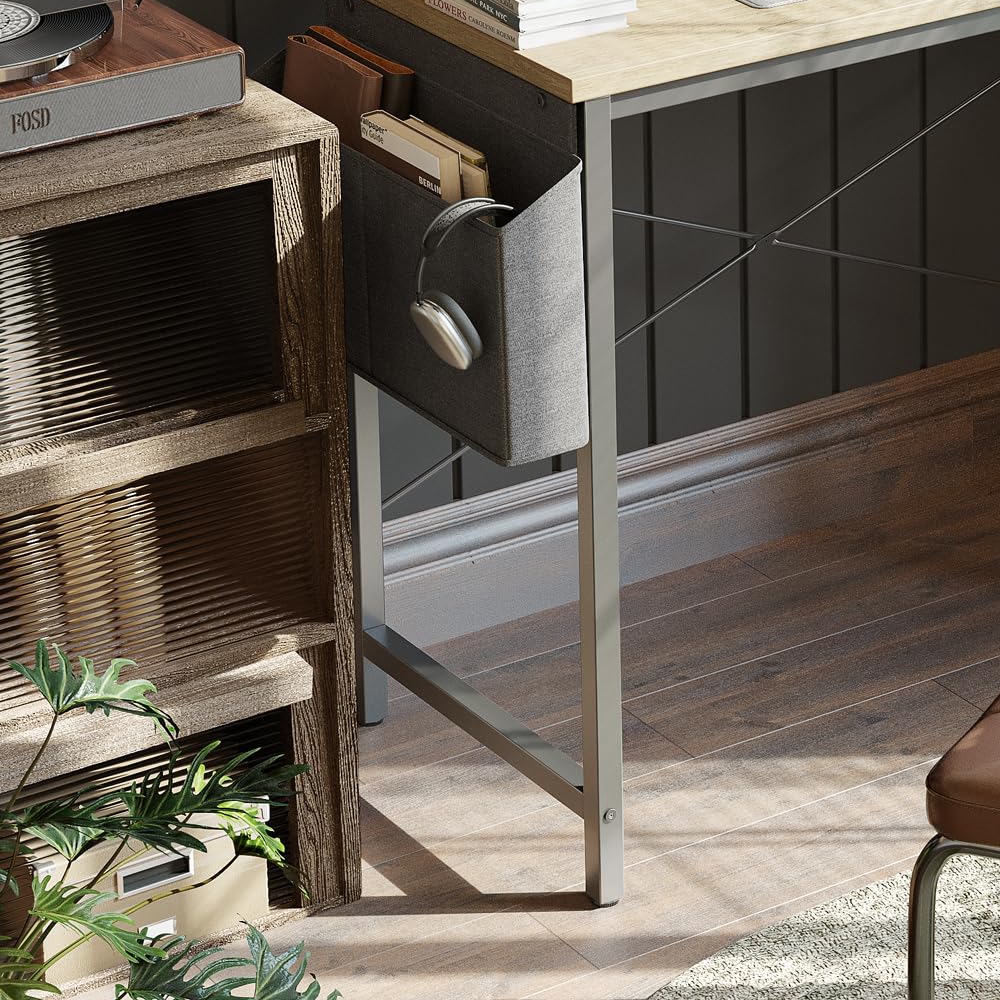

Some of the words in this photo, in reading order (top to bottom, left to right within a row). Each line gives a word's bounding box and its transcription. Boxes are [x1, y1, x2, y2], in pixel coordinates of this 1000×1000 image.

[479, 0, 494, 14] PARK
[495, 10, 508, 22] NYC
[468, 15, 496, 33] CAROLYNE
[368, 129, 384, 145] Guide
[418, 175, 441, 195] BERLIN
